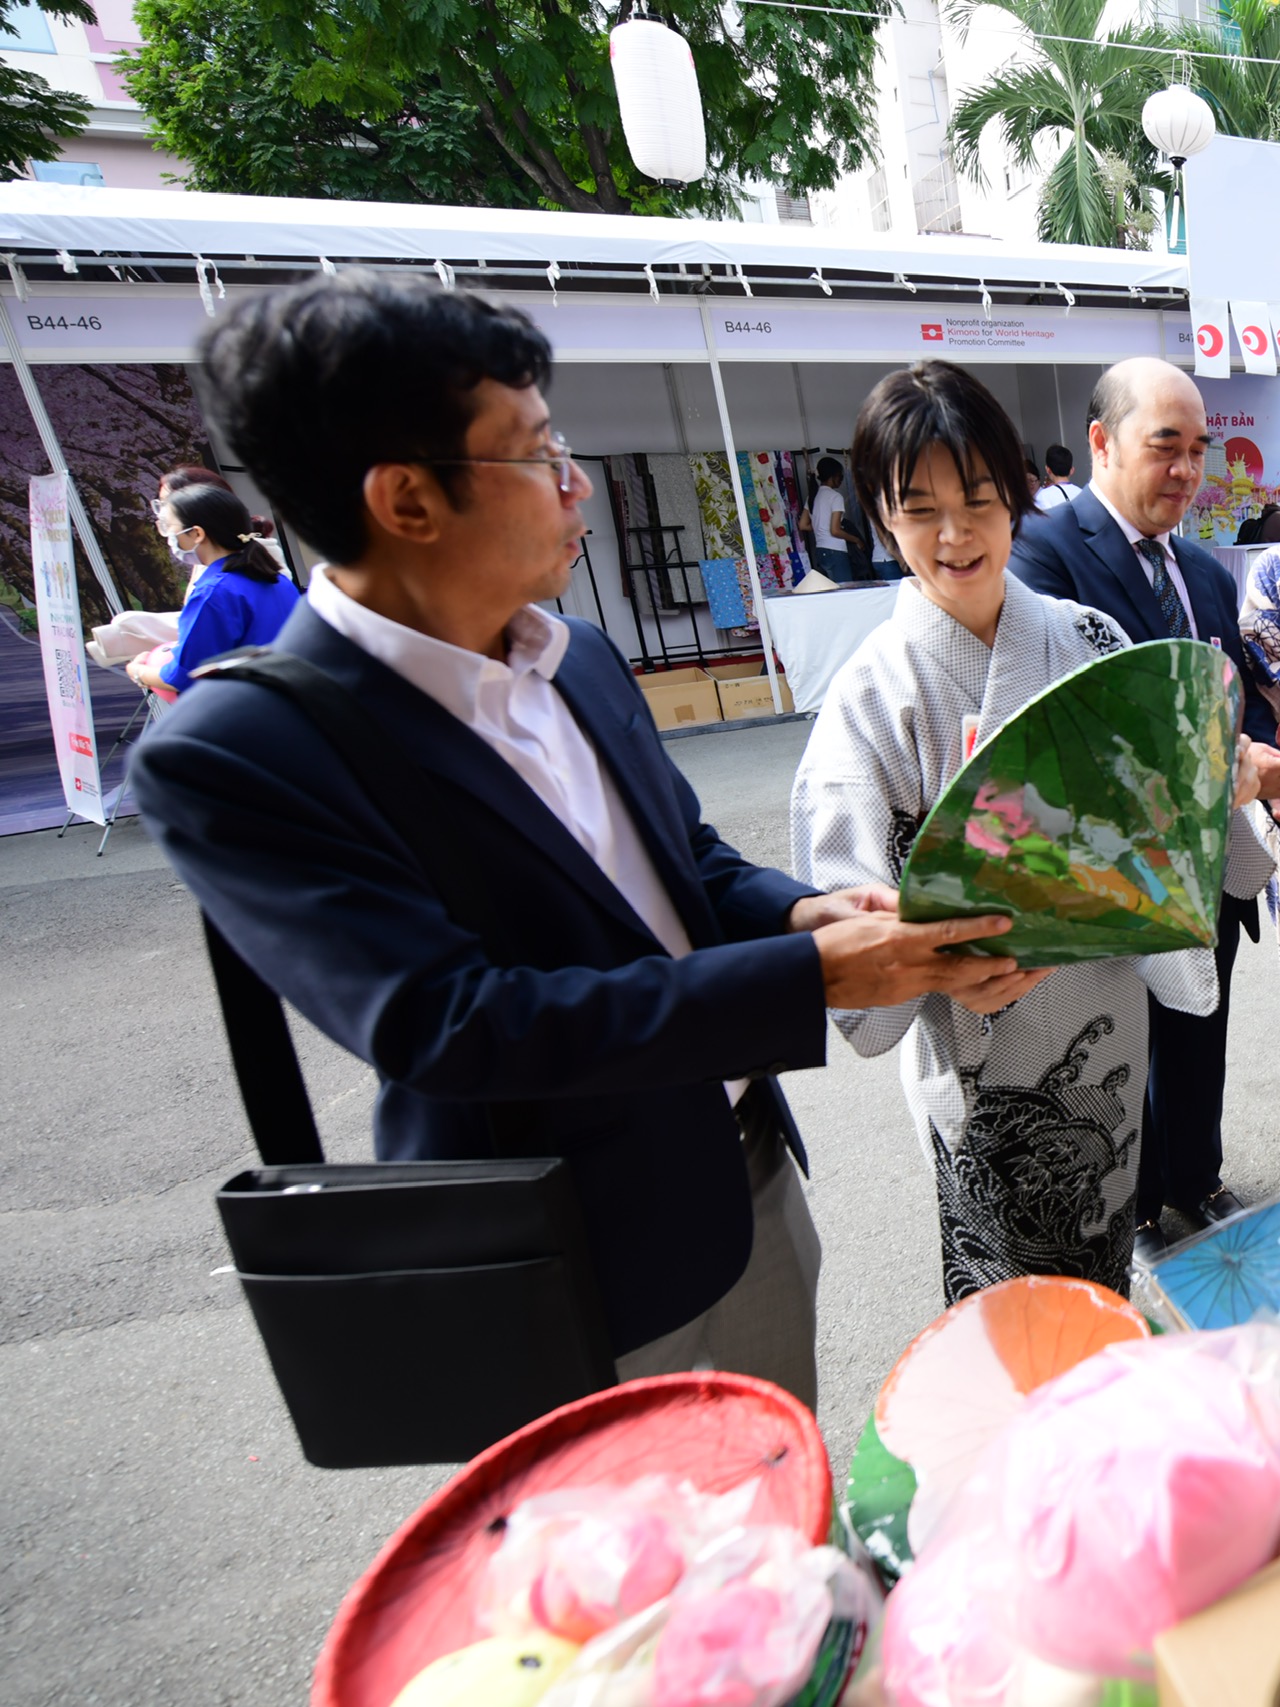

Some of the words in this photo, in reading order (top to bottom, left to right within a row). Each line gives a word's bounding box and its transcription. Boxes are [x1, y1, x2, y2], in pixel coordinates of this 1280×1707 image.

[27, 315, 102, 331] B44-46
[724, 320, 772, 333] B44-46
[946, 318, 980, 328] Nonprofit
[981, 319, 1025, 329] organization
[947, 328, 980, 337] Kimono
[981, 329, 993, 337] for
[994, 329, 1019, 338] World
[1021, 329, 1055, 340] Heritage
[949, 337, 986, 346] Promotion
[987, 338, 1026, 347] Committee
[1206, 412, 1229, 430] HẬT
[1231, 409, 1255, 427] BẢN
